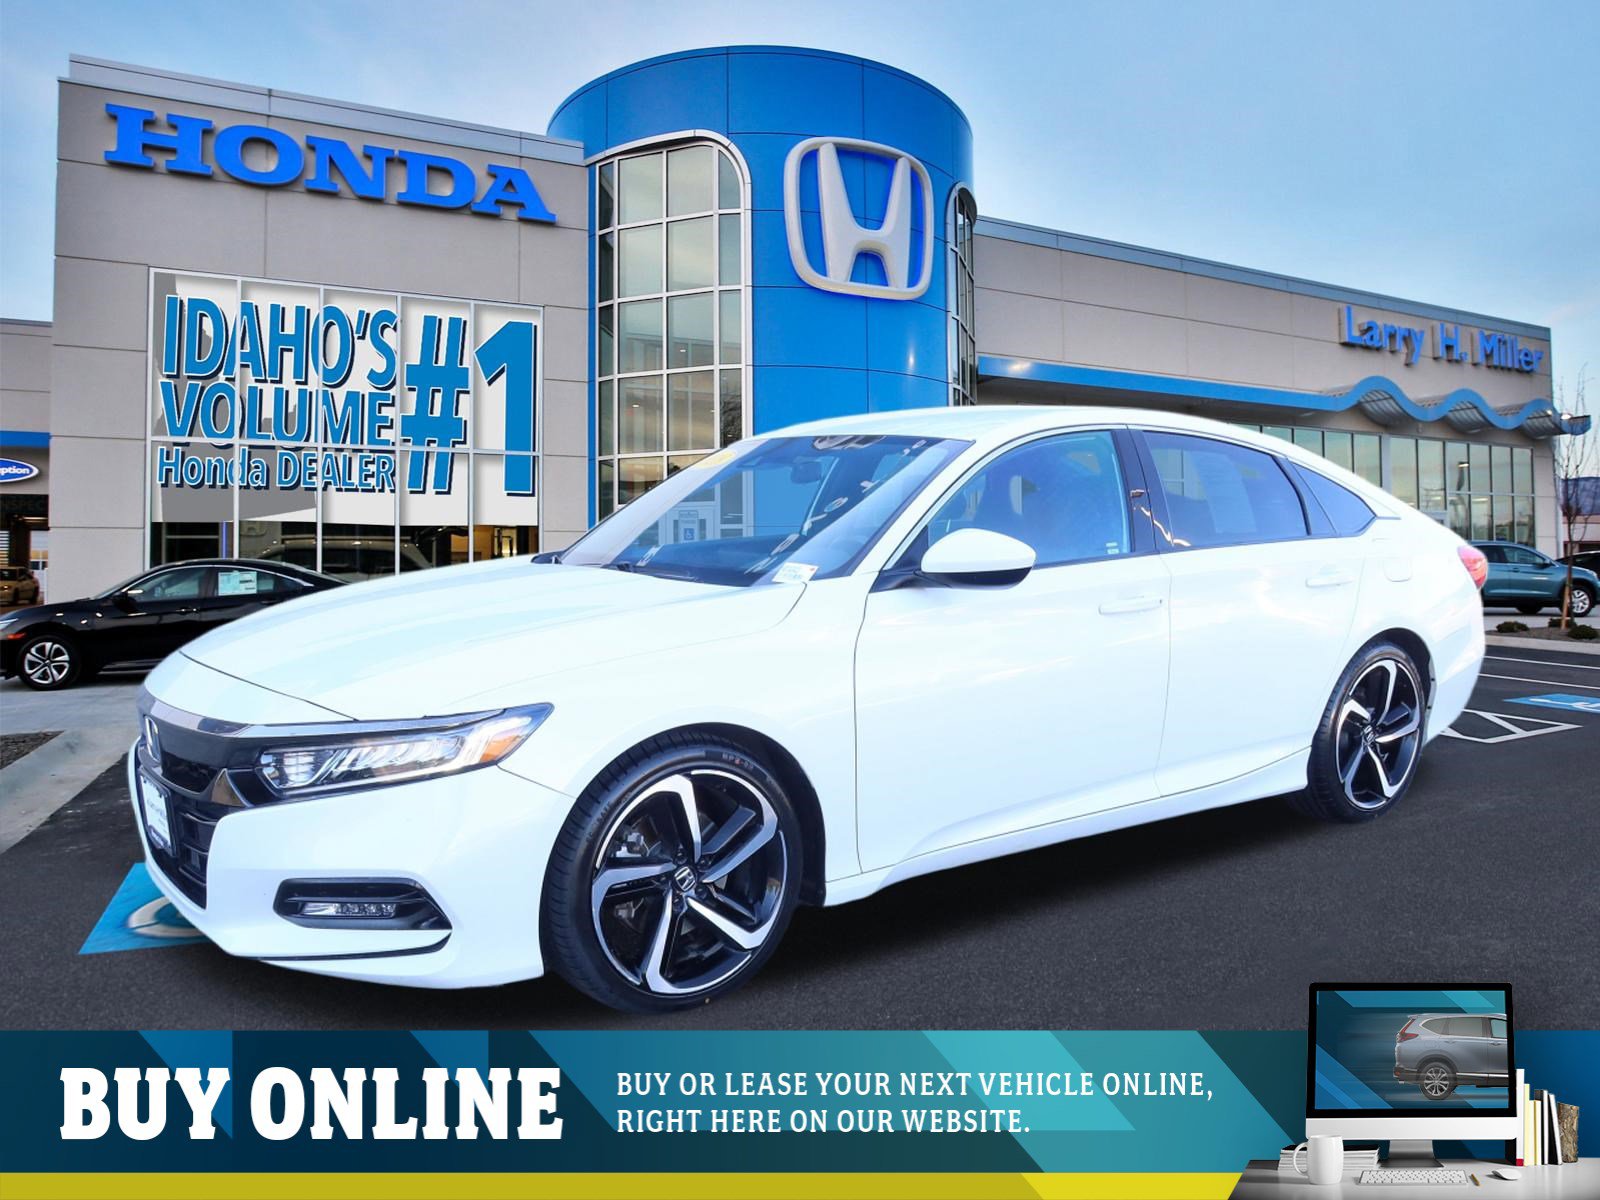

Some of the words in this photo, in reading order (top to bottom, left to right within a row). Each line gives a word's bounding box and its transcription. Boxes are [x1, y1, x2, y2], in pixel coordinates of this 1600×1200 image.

[104, 103, 557, 224] HONDA
[162, 294, 398, 388] IDAHO'S
[1339, 305, 1425, 366] Larry
[1433, 322, 1468, 362] H.
[1472, 330, 1545, 373] Miller
[159, 379, 397, 449] VOLUME
[400, 314, 537, 497] #1
[0, 465, 30, 476] ption
[157, 446, 270, 489] Honda
[276, 450, 397, 492] DEALER
